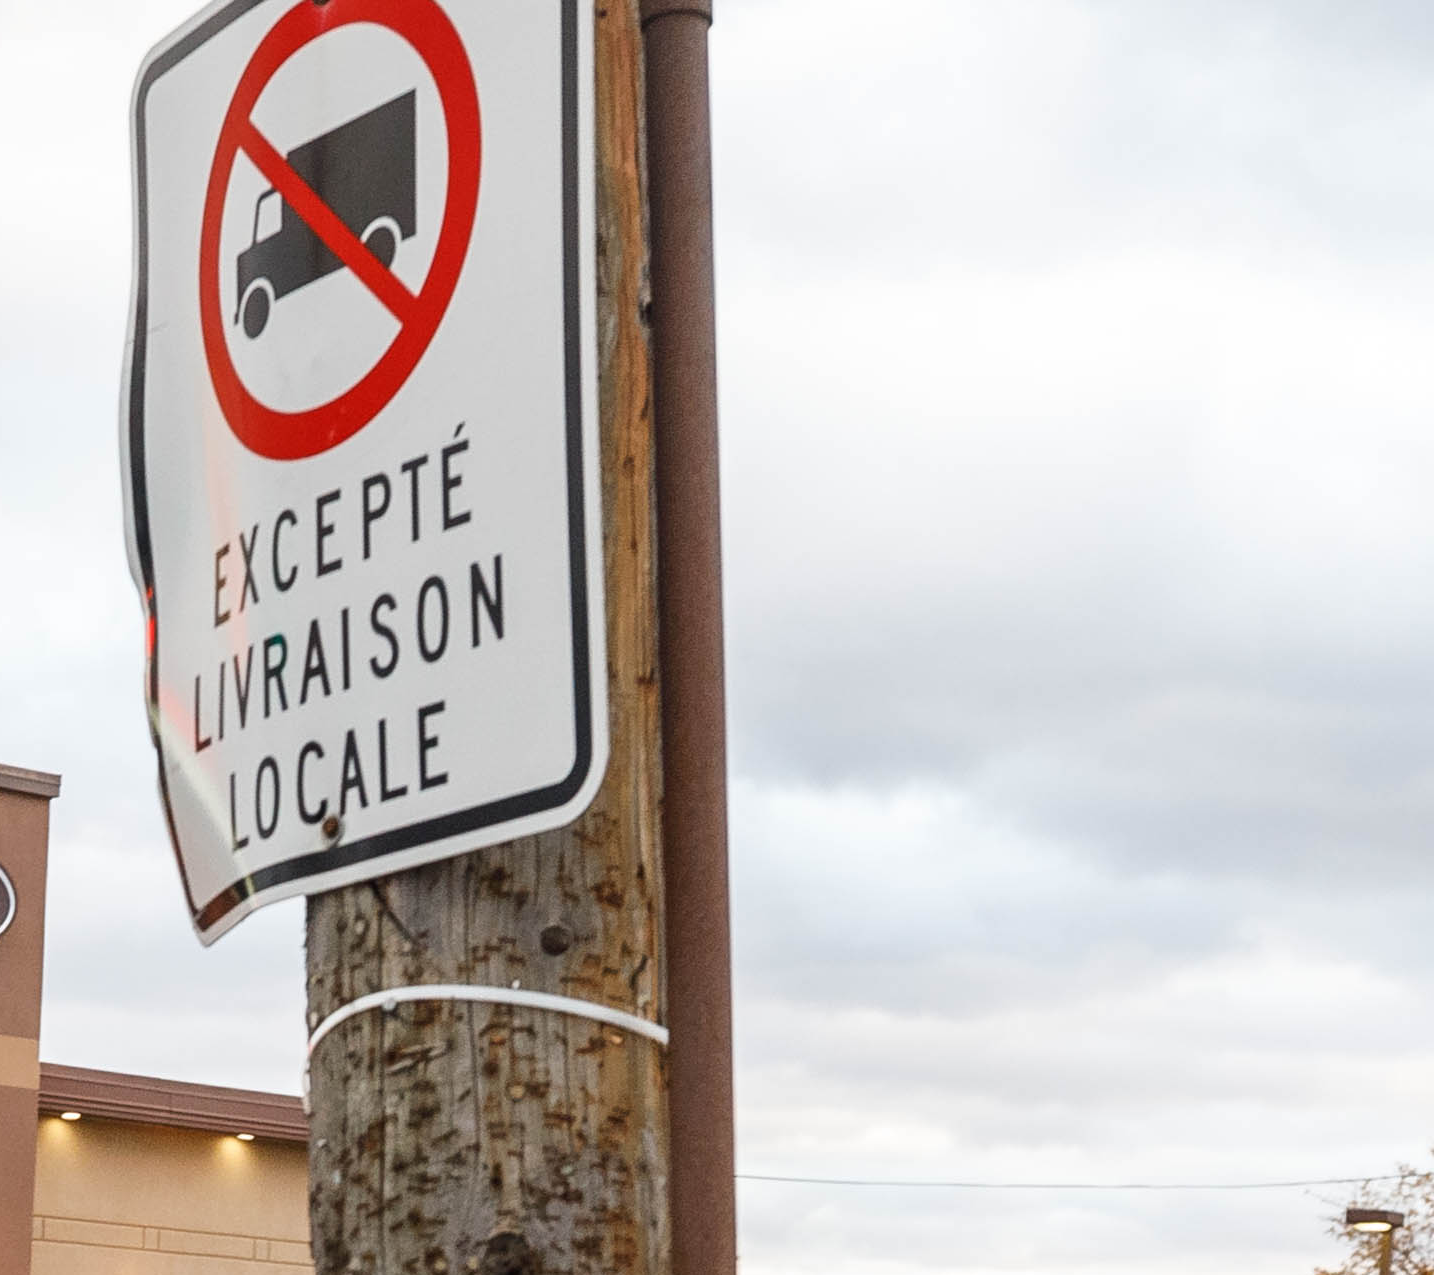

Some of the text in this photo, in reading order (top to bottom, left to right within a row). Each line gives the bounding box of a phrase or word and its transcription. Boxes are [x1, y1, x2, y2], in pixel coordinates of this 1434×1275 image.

[214, 422, 472, 628] EXCEPTÉ
[194, 554, 505, 753] LIVRAISON
[230, 701, 449, 852] LOCALE
